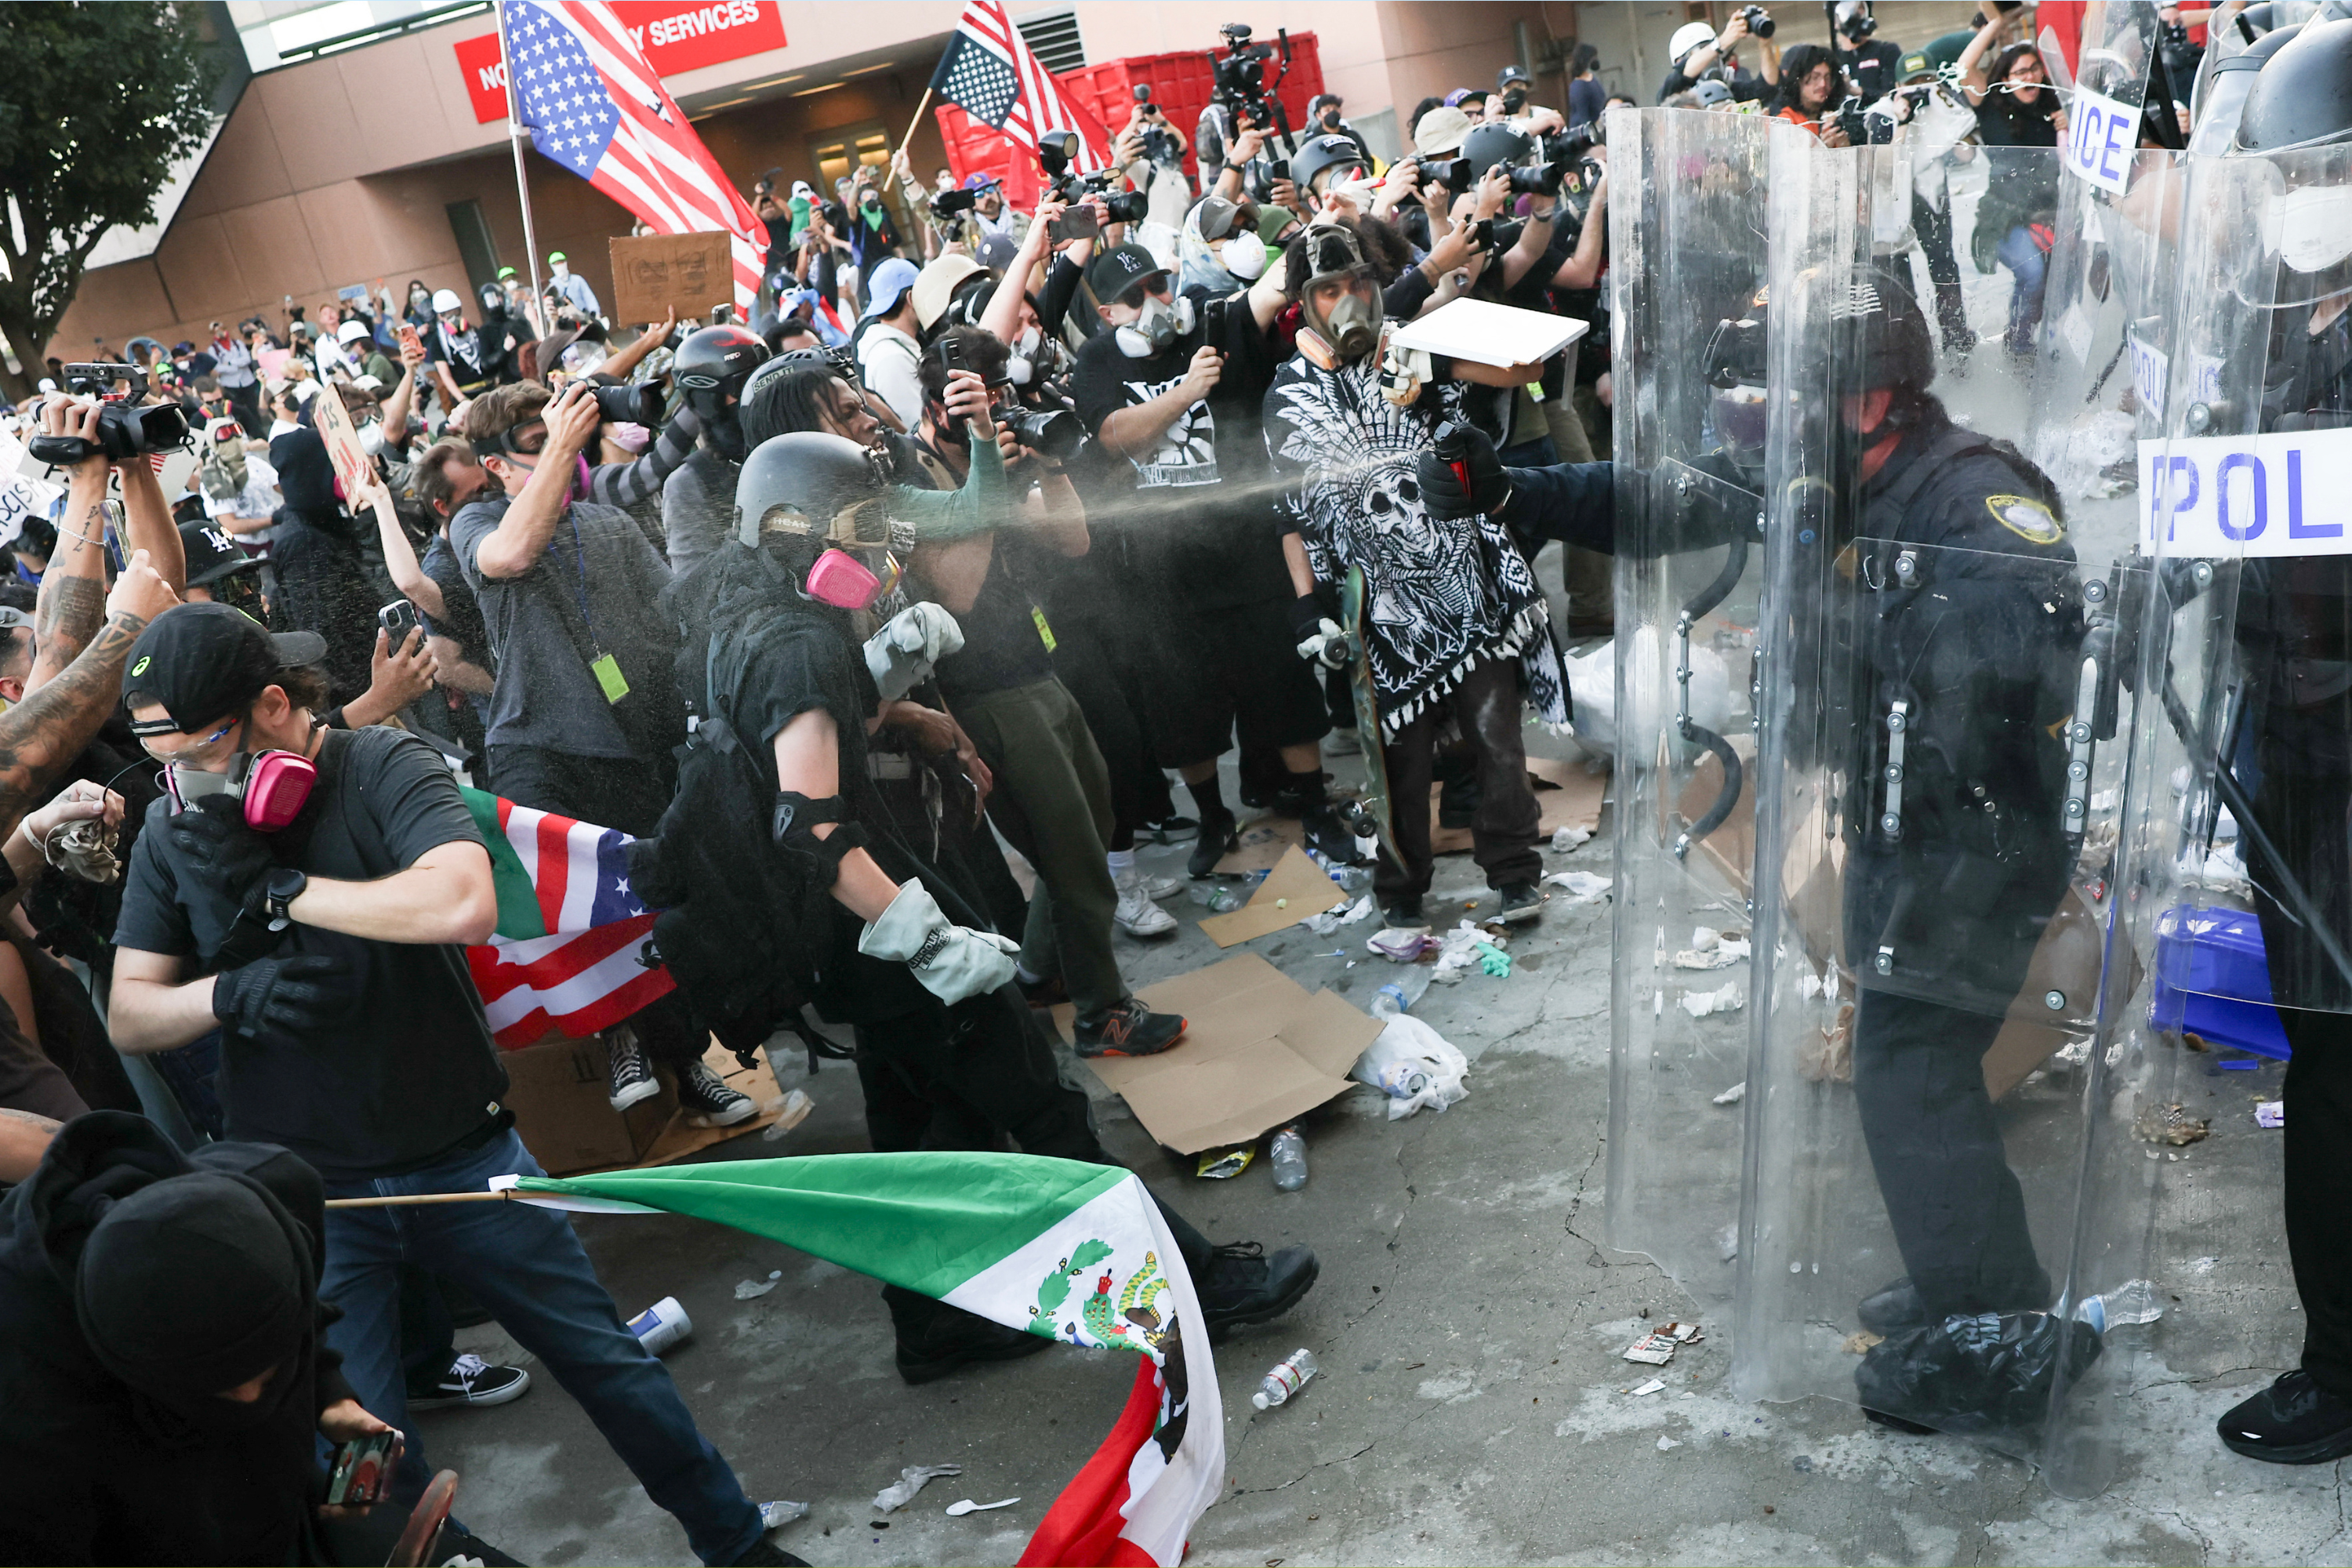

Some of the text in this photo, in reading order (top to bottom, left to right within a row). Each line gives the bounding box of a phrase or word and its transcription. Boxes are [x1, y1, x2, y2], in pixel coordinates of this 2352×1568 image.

[648, 1, 760, 46] SERVICES
[753, 372, 780, 392] SEND
[2151, 449, 2343, 542] POL
[909, 931, 939, 968] LINCOLN
